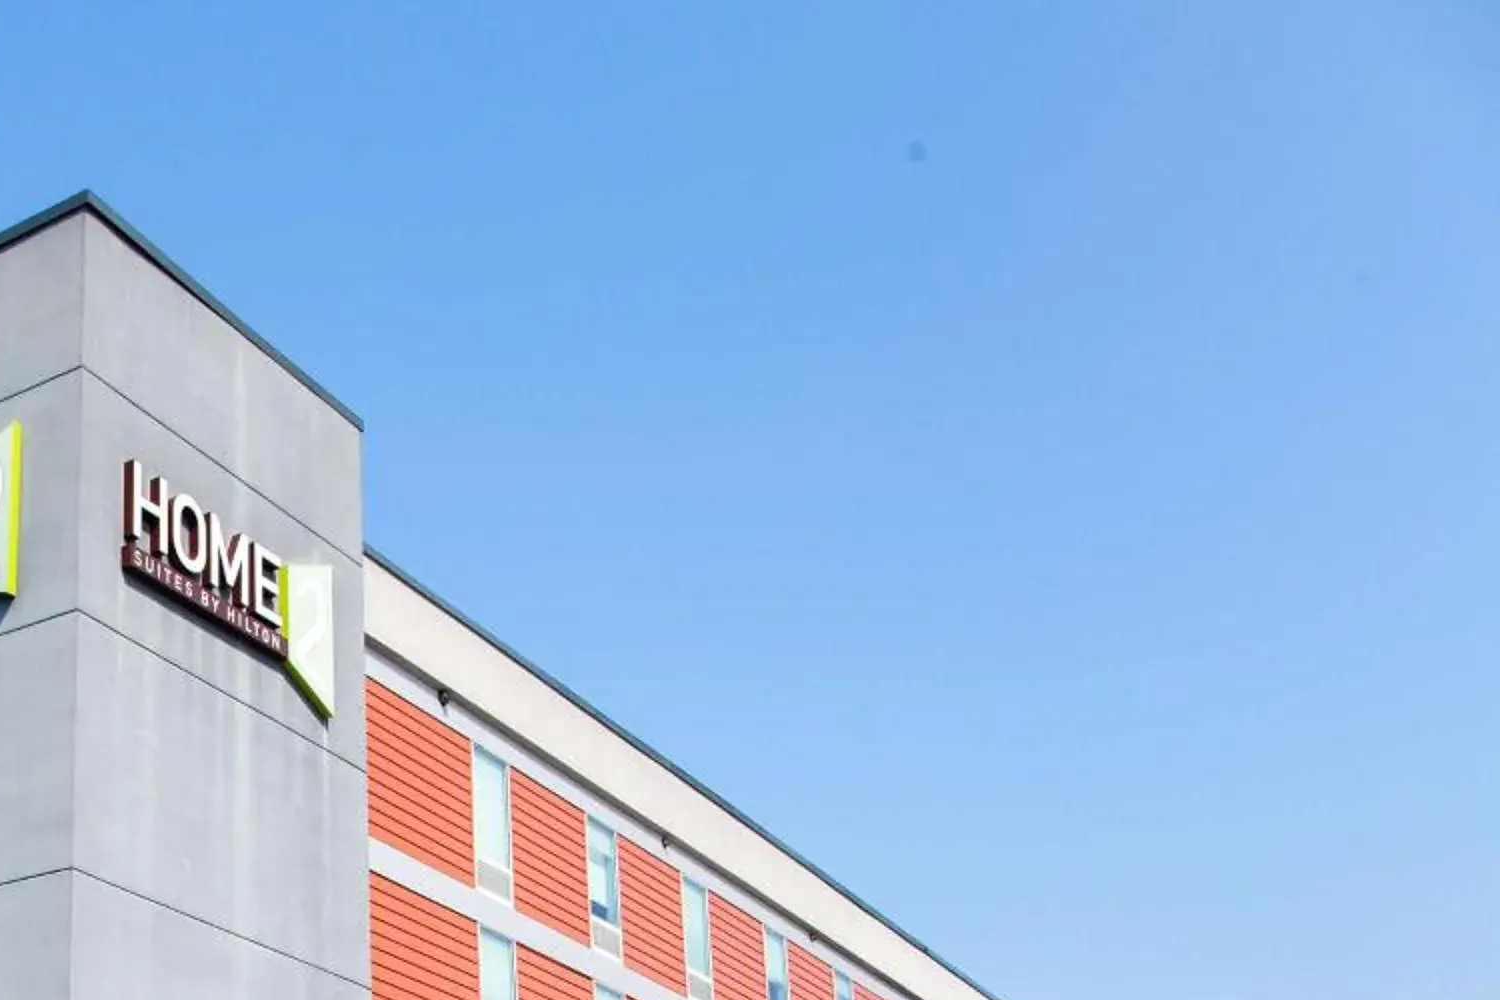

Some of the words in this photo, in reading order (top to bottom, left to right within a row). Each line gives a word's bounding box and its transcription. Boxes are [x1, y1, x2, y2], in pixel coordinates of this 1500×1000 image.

[126, 459, 282, 628] HOME
[133, 550, 193, 597] SUITES
[201, 590, 219, 613] BY
[226, 605, 281, 650] HILTON
